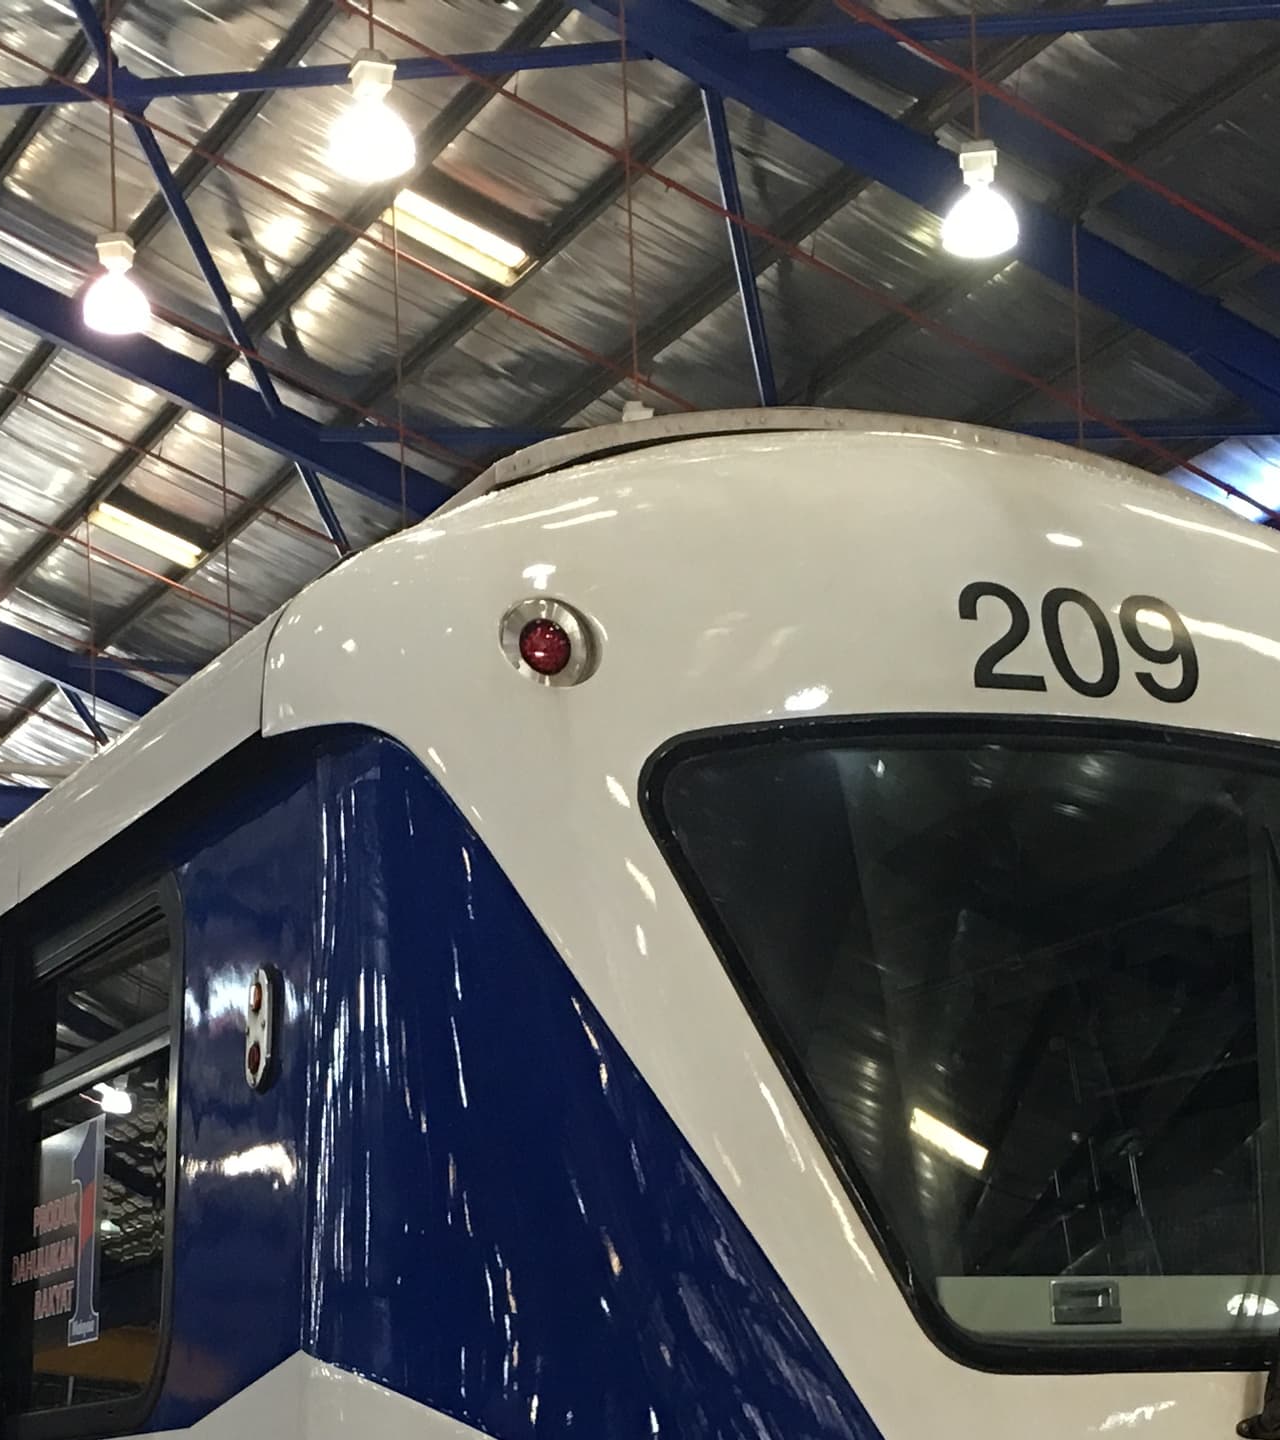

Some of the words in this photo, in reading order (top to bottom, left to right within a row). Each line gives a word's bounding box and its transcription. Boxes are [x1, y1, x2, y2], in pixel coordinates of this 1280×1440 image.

[958, 581, 1199, 703] 209
[33, 1192, 78, 1238] PRODUK
[34, 1280, 75, 1321] RAKYAT
